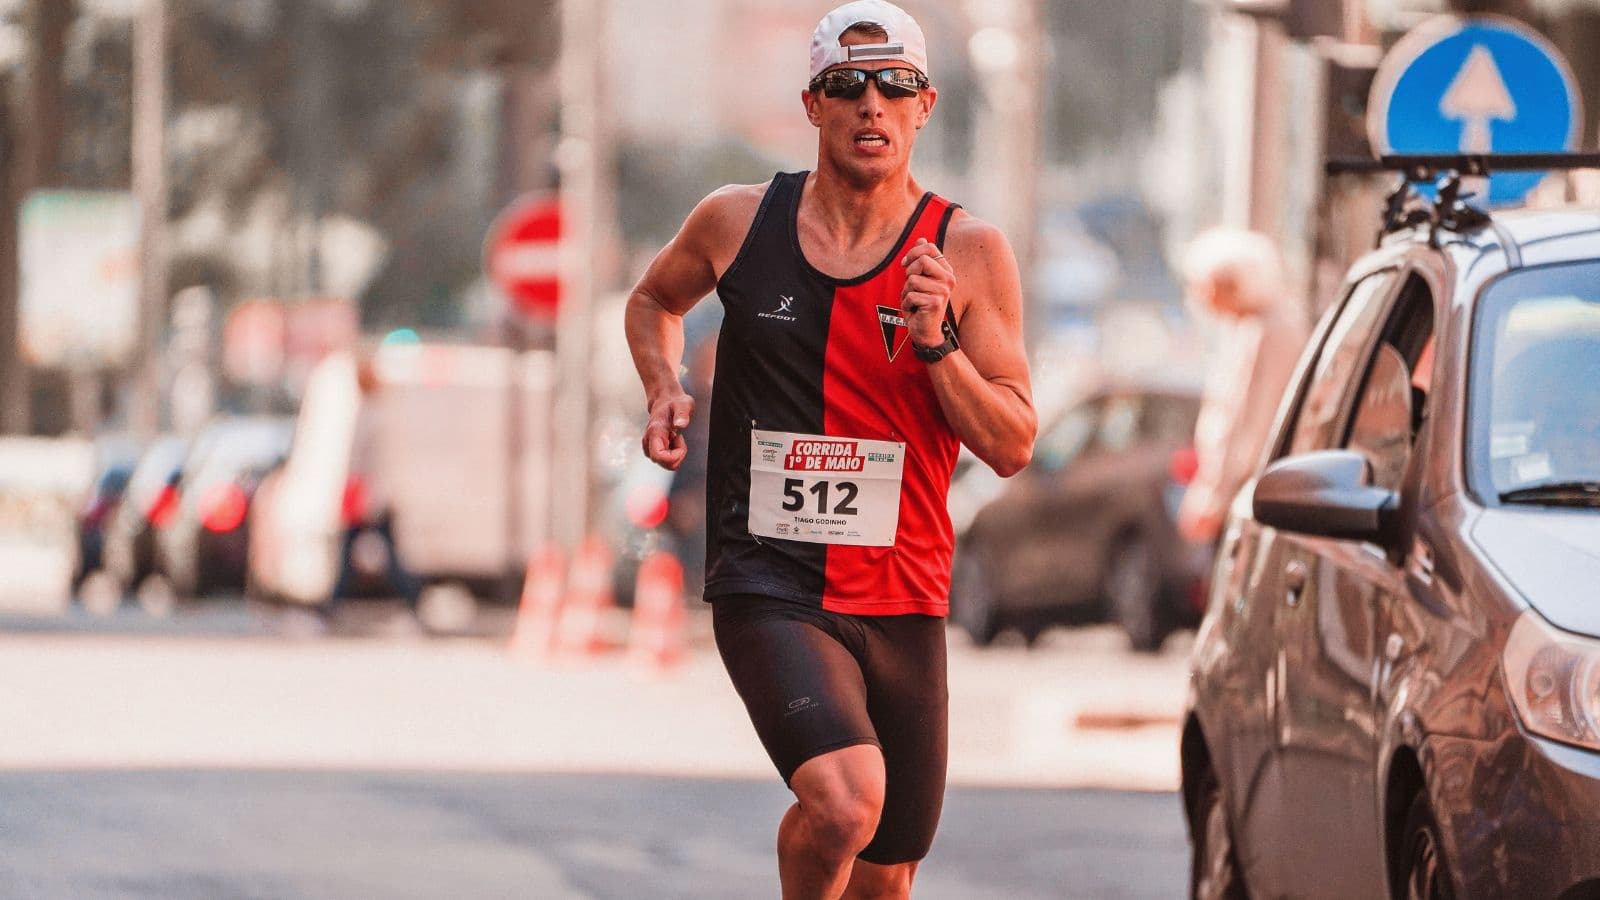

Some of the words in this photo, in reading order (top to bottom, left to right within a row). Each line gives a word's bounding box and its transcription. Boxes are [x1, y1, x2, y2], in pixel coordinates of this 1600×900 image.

[795, 441, 853, 456] CORRIDA
[805, 456, 822, 469] DE
[824, 456, 861, 470] MAIO
[782, 477, 859, 516] 512
[794, 516, 814, 524] TIAGO
[815, 518, 847, 526] GODINHO
